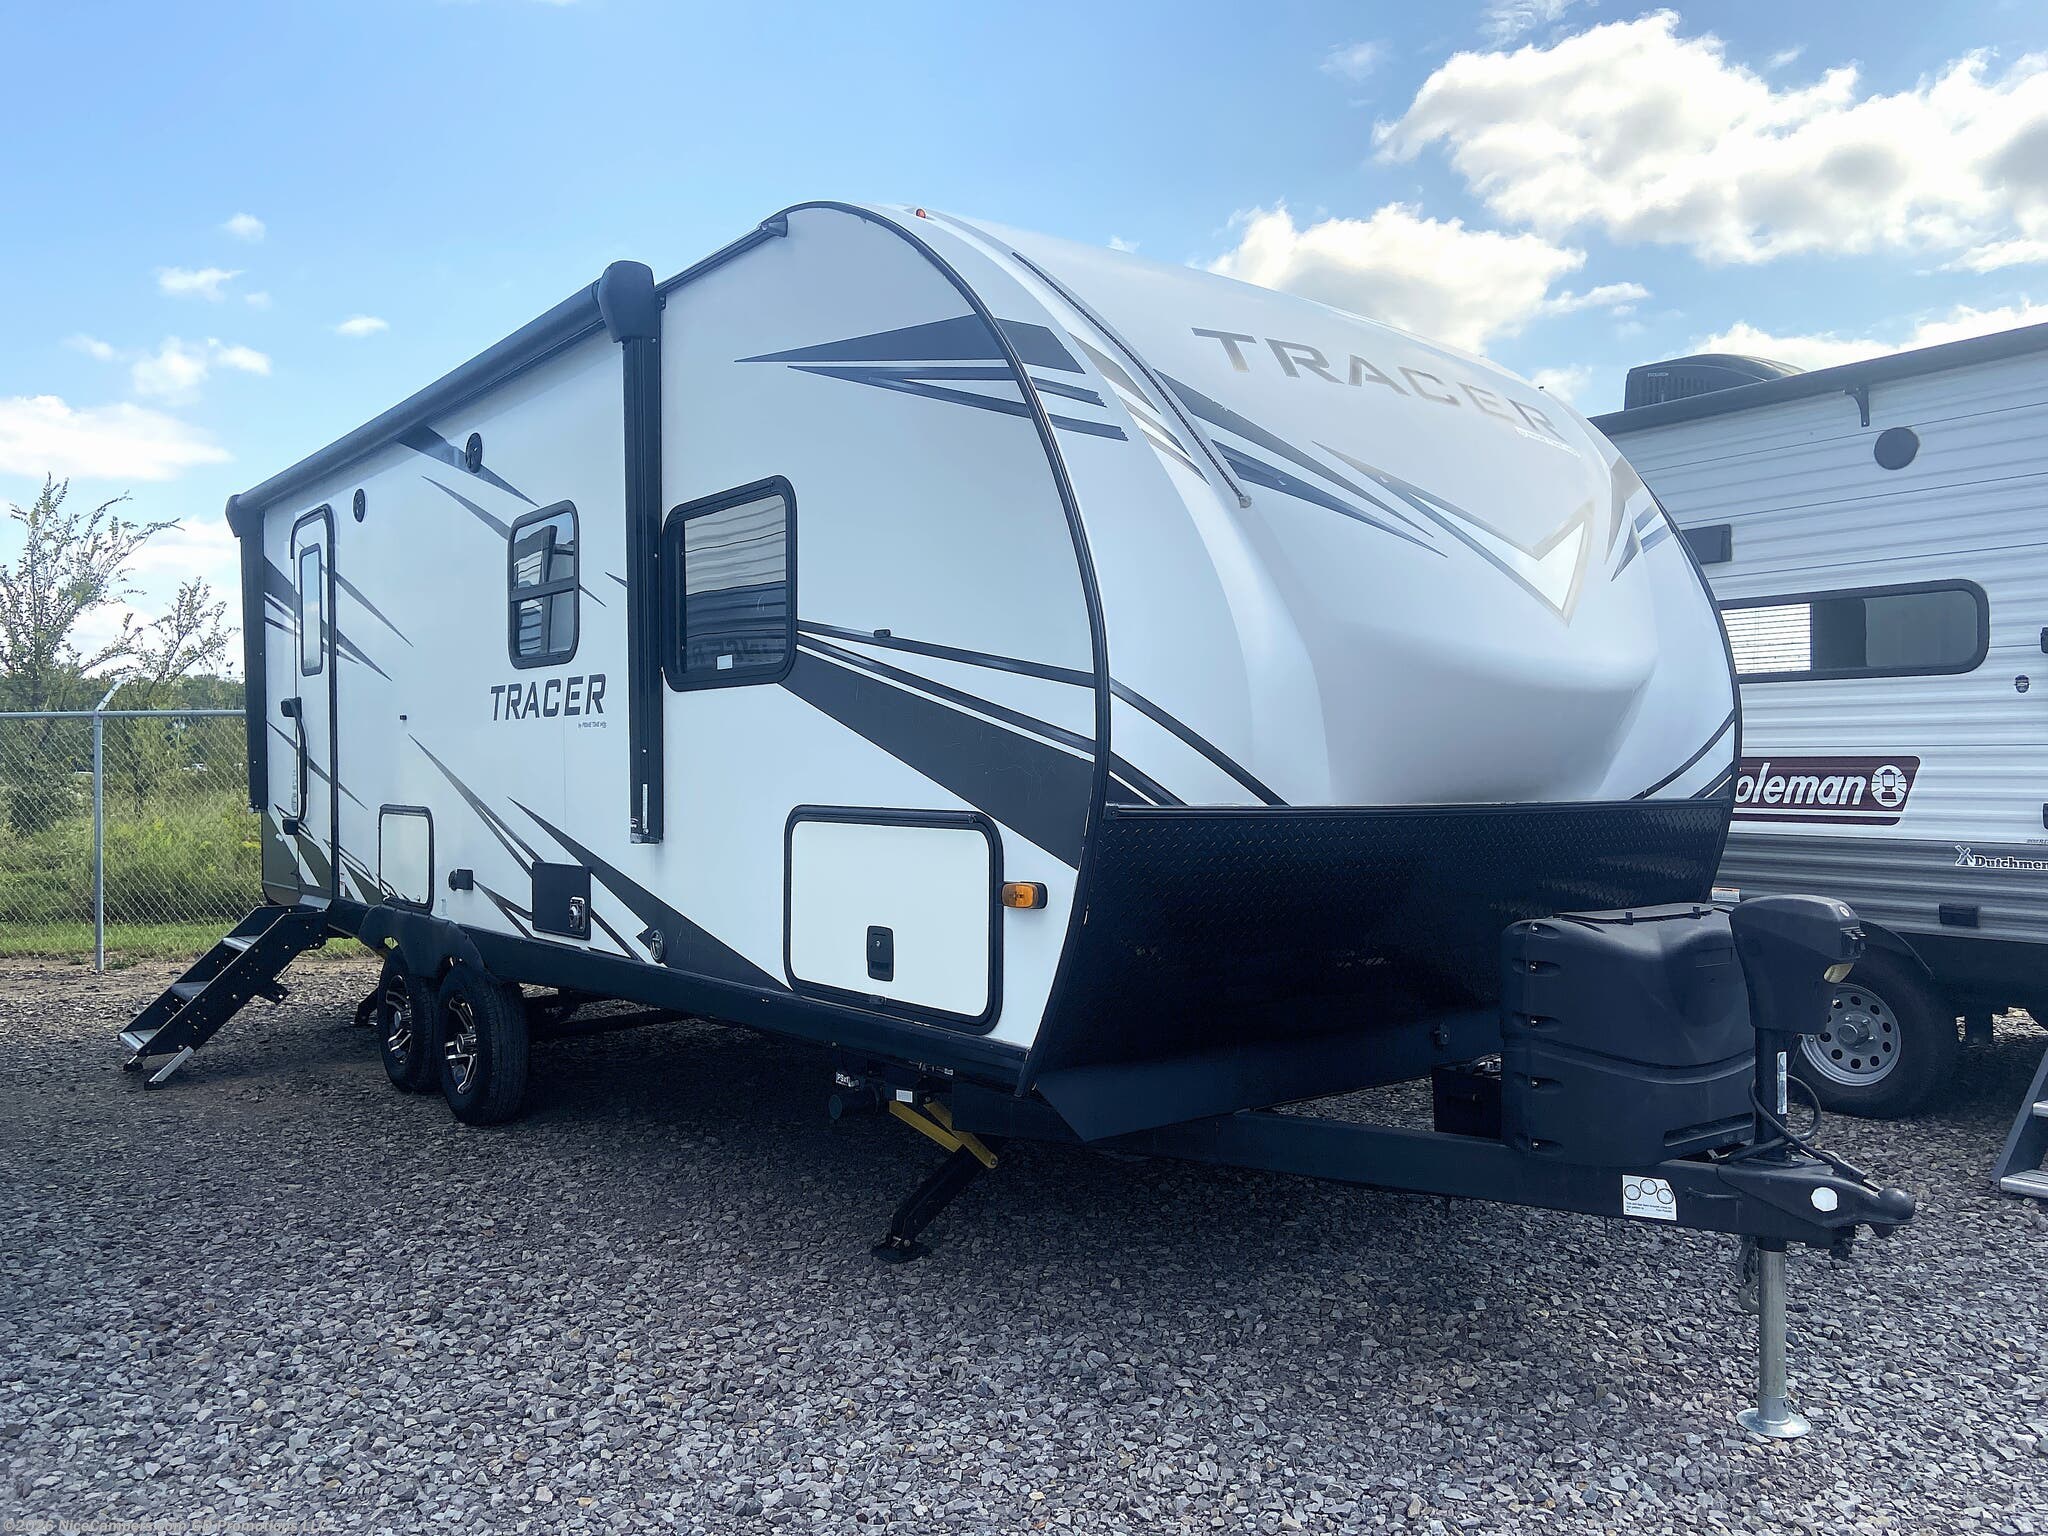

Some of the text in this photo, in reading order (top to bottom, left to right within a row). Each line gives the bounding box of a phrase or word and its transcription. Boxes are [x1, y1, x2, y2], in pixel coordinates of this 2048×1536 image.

[1190, 326, 1569, 442] TRACER
[490, 673, 606, 721] TRACER
[1735, 762, 1867, 805] oleman
